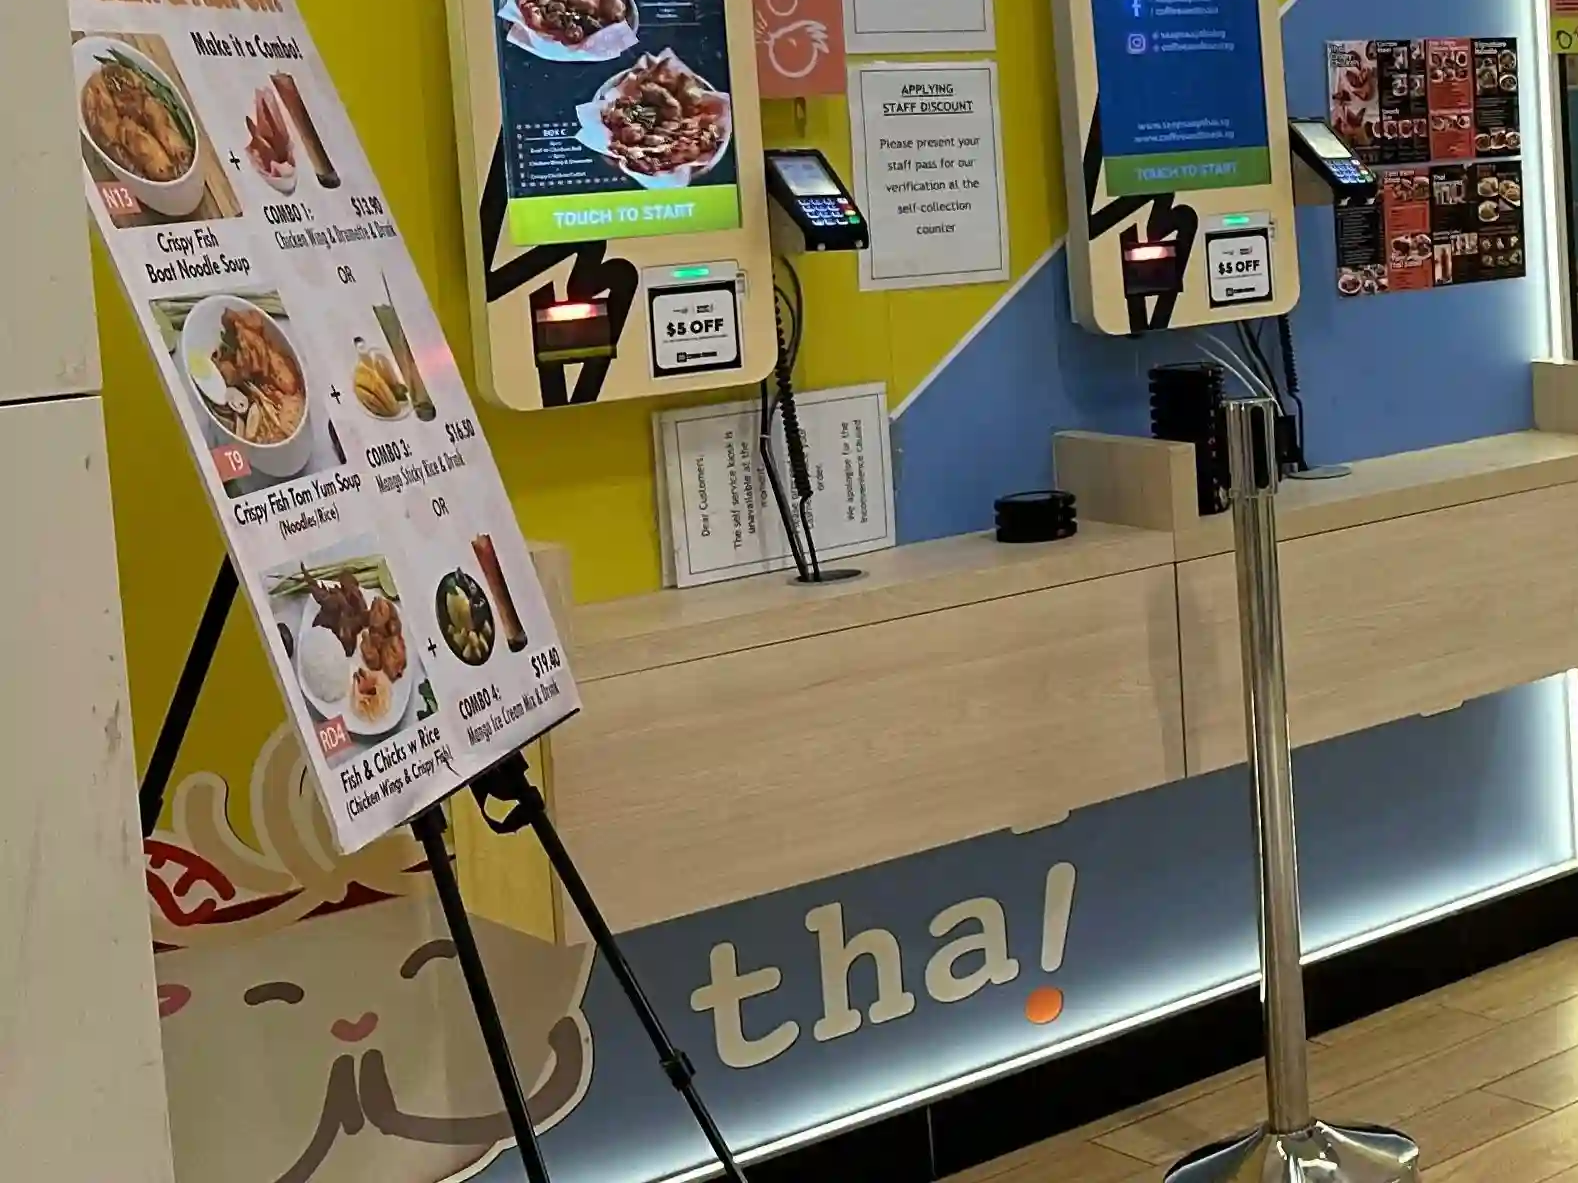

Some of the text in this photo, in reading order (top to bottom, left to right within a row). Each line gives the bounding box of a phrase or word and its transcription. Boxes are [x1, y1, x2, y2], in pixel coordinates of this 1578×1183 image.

[190, 32, 303, 60] Make it a Combo!
[901, 84, 954, 97] APPLYING
[883, 100, 973, 116] STAFF DISCOUNT
[880, 137, 980, 150] Please present your
[888, 158, 975, 172] staff pass for our
[1135, 162, 1237, 181] TOUCH TO START
[886, 178, 980, 193] verification at the
[103, 186, 134, 209] N13
[264, 205, 301, 223] COMBO
[351, 196, 384, 216] $13.90
[554, 202, 696, 228] TOUCH TO START
[157, 226, 219, 255] Crispy Fish
[916, 223, 956, 235] counter
[146, 254, 250, 284] Boat Noodle Soup
[337, 266, 356, 284] OR
[1218, 260, 1260, 276] $5 OFF
[666, 318, 724, 337] $5 OFF
[446, 418, 475, 445] $16.50
[224, 450, 244, 472] T9
[365, 445, 396, 470] COMBO
[727, 441, 736, 468] kiosk
[234, 471, 361, 526] Crispy Fish Tom Yum Soup
[729, 469, 738, 508] service
[741, 441, 755, 534] unavailable at the
[432, 497, 450, 517] OR
[733, 510, 741, 531] self
[733, 533, 742, 550] The
[530, 646, 561, 679] $19.40
[319, 727, 347, 751] RD4
[341, 770, 363, 794] Fish
[374, 741, 407, 774] Chicks
[418, 724, 441, 750] Rice
[688, 860, 1078, 1071] tha!
